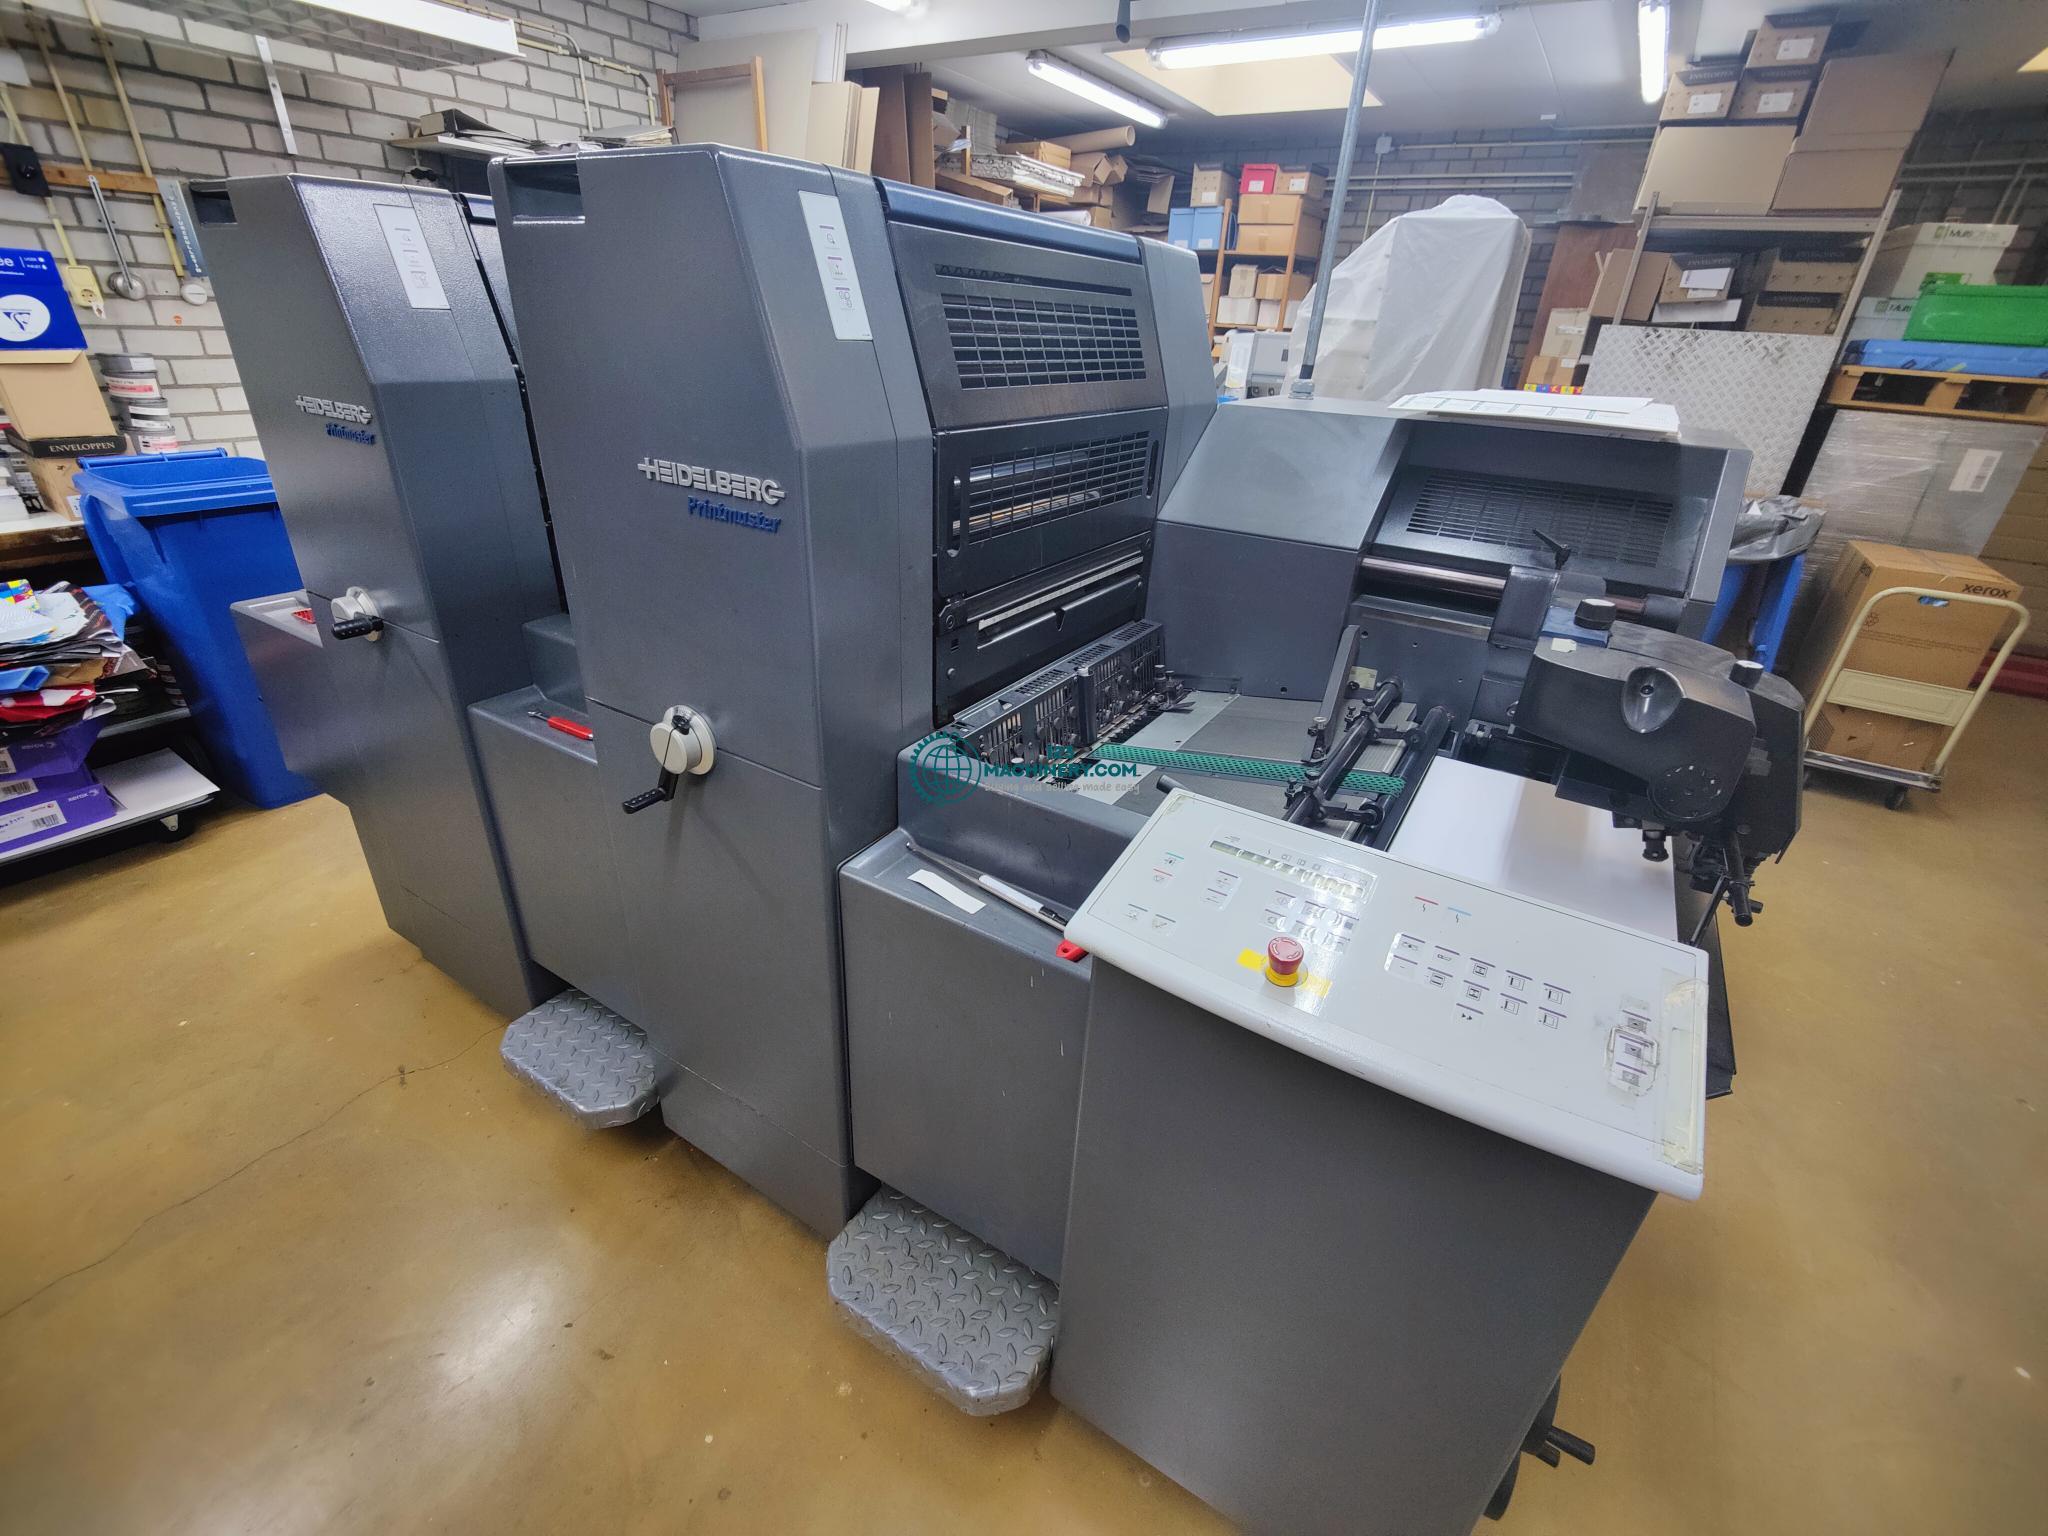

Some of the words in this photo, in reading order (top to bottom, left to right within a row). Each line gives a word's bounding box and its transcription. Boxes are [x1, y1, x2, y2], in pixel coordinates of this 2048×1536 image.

[295, 394, 372, 424] HEIDELBERG
[49, 441, 116, 453] ENVELOPPEN
[637, 457, 785, 505] HEIDELBERG
[687, 495, 782, 534] Printmaster
[1962, 583, 2011, 599] xerox
